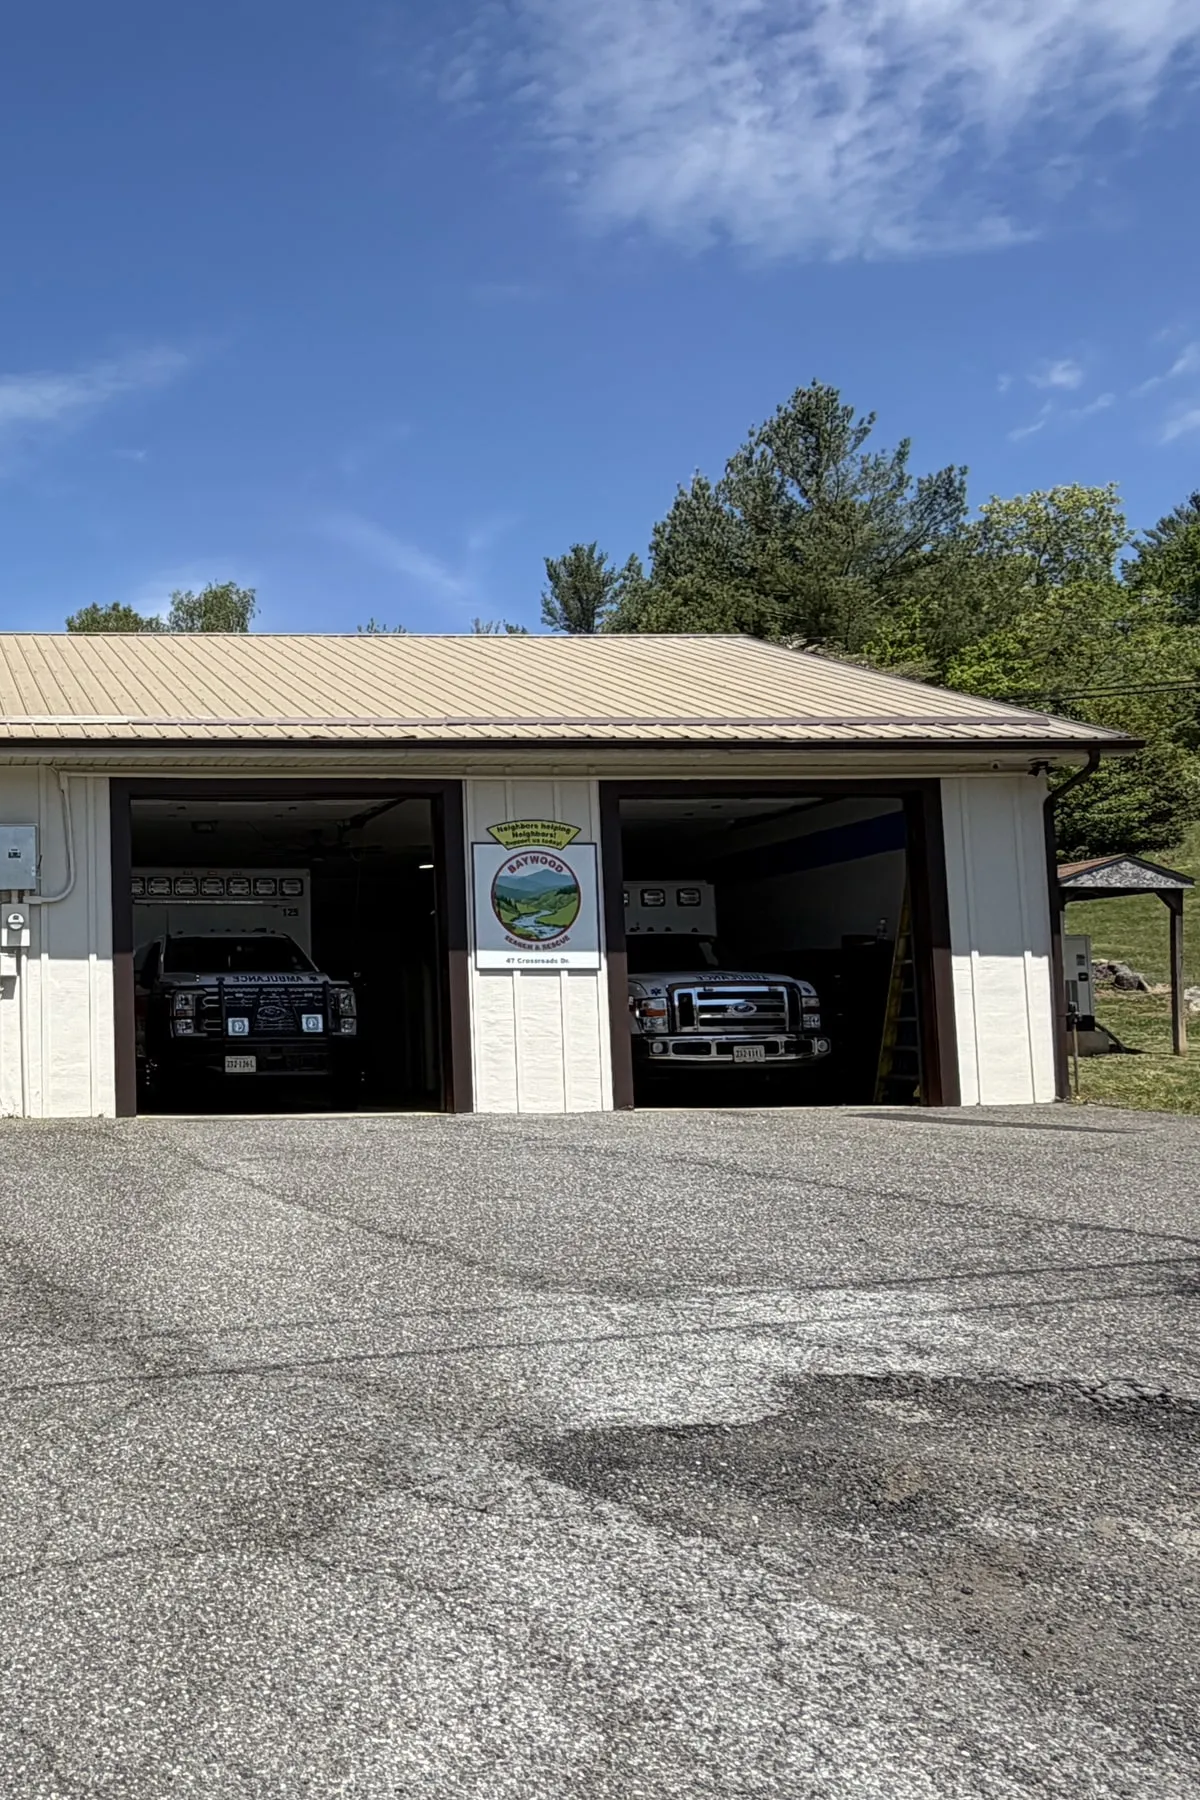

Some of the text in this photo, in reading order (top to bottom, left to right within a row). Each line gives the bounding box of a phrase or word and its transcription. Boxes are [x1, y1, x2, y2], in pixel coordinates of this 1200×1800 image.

[497, 823, 572, 834] Neighbors helping
[512, 831, 557, 839] Neighbors!
[507, 855, 564, 874] BAYWOOD
[504, 935, 533, 950] SEARCH
[542, 935, 571, 950] RESCUE
